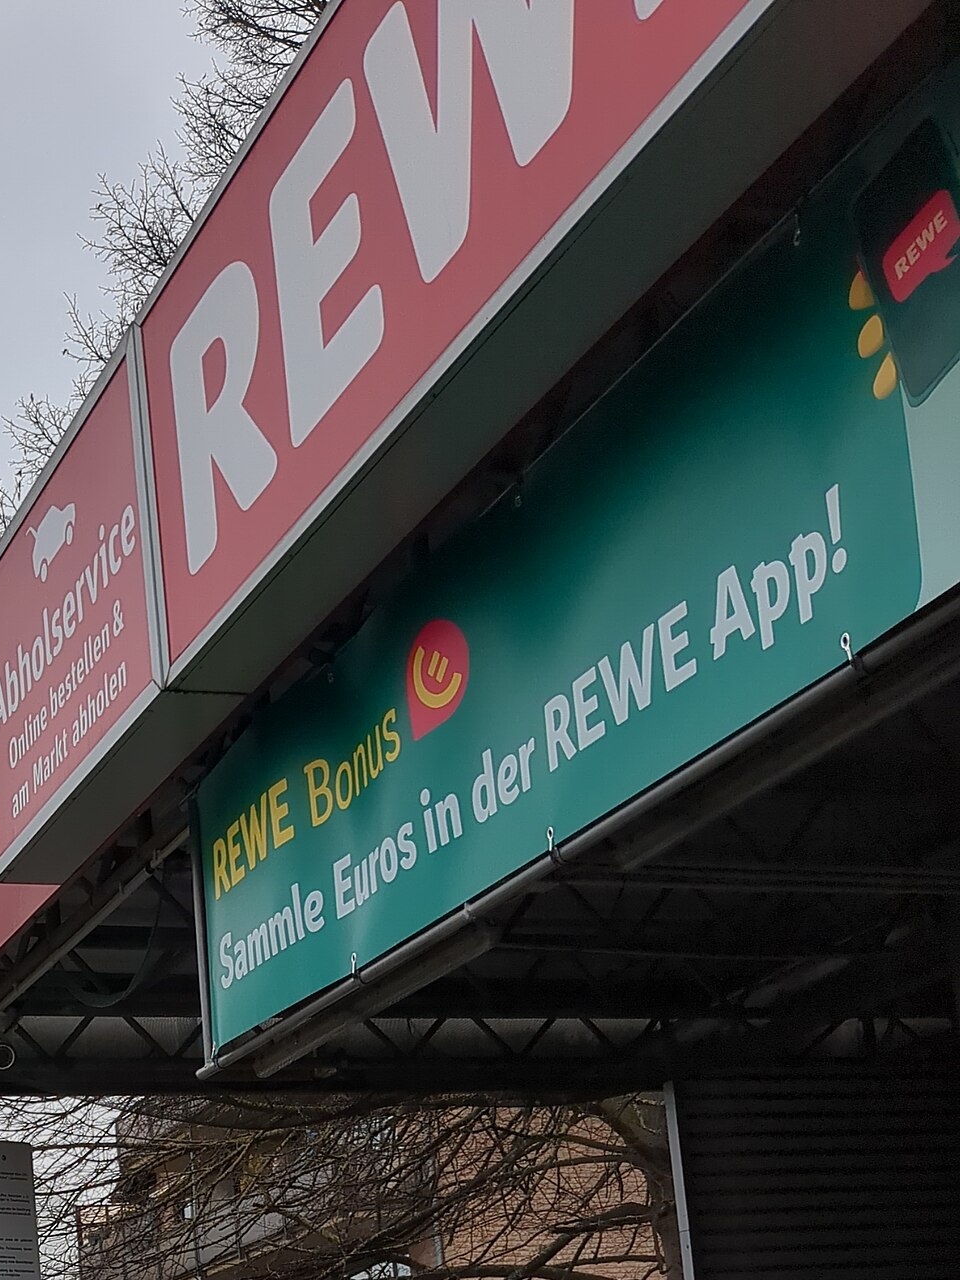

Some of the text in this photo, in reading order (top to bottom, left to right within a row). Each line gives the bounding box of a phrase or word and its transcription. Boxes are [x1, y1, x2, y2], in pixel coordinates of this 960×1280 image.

[170, 0, 662, 575] REW
[894, 210, 948, 280] REWE
[8, 600, 125, 769] Online bestellen &
[12, 661, 127, 818] am Markt abholen
[219, 483, 847, 989] Sammle Euros in der REWE App!
[212, 708, 401, 900] REWE Bonus
